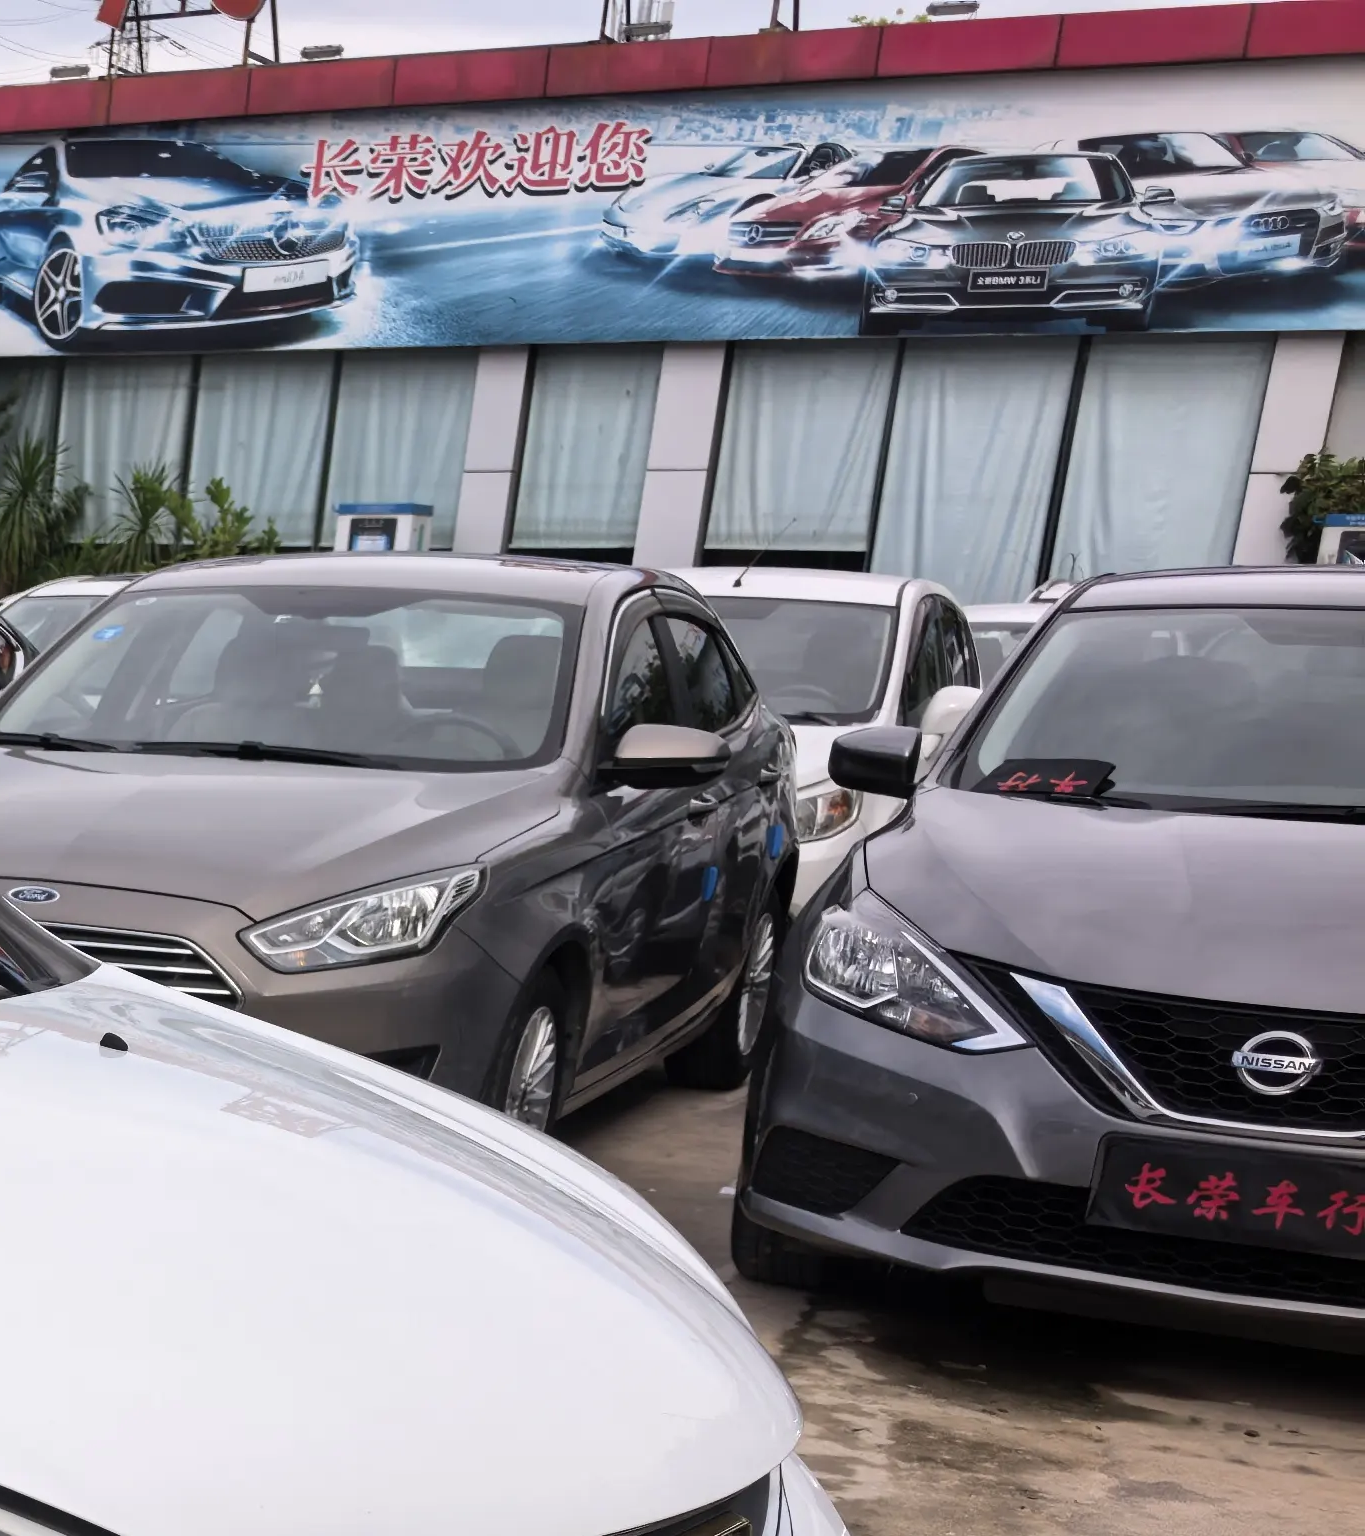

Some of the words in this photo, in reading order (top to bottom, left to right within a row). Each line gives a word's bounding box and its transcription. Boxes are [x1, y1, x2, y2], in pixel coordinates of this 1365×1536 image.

[302, 121, 650, 203] 长荣欢迎您
[1240, 1055, 1314, 1072] NISSAN
[1125, 1162, 1365, 1236] 长荣车行
